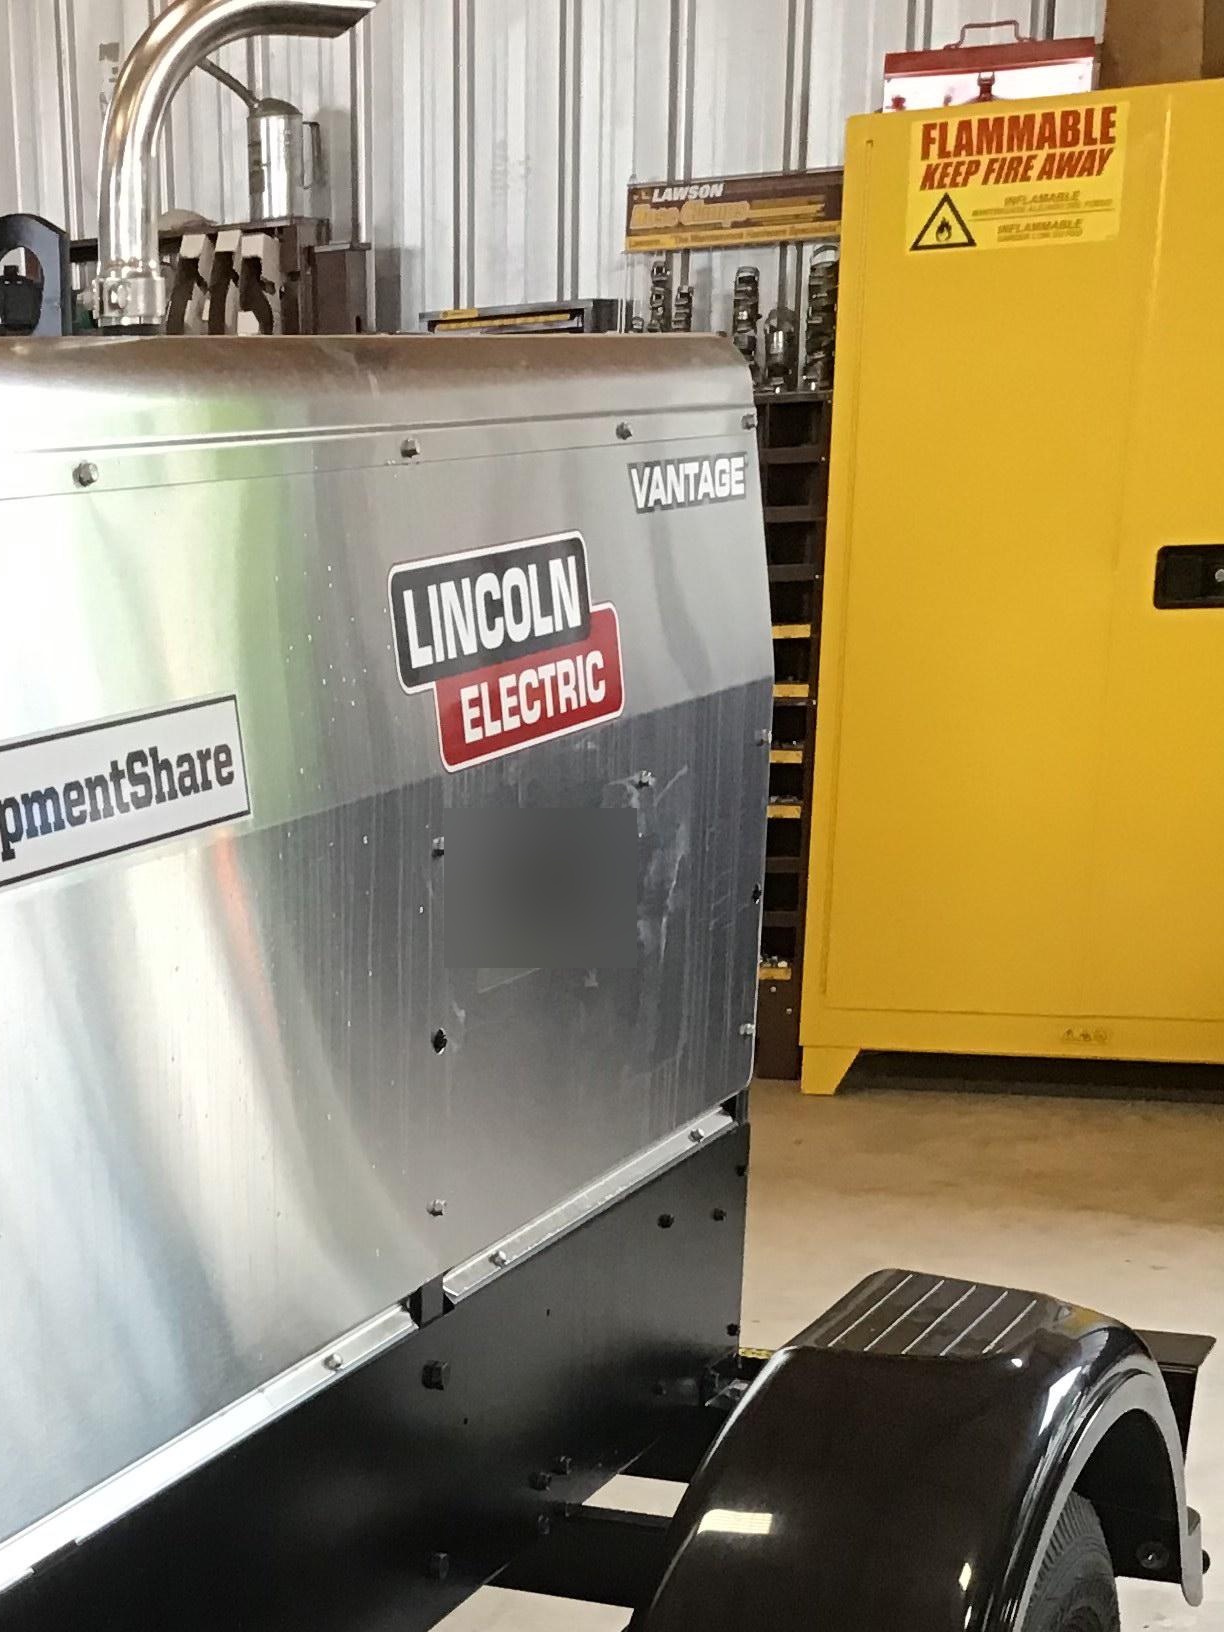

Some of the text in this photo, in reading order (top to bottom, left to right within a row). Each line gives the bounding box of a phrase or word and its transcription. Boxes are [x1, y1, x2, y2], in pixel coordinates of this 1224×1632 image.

[921, 106, 1118, 160] FLAMMABLE
[652, 183, 725, 203] LAWSON
[919, 148, 1115, 191] KEEP FIRE AWAY
[631, 456, 746, 509] VANTAGE
[402, 555, 582, 669] LINCOLN
[460, 650, 606, 744] ELECTRIC
